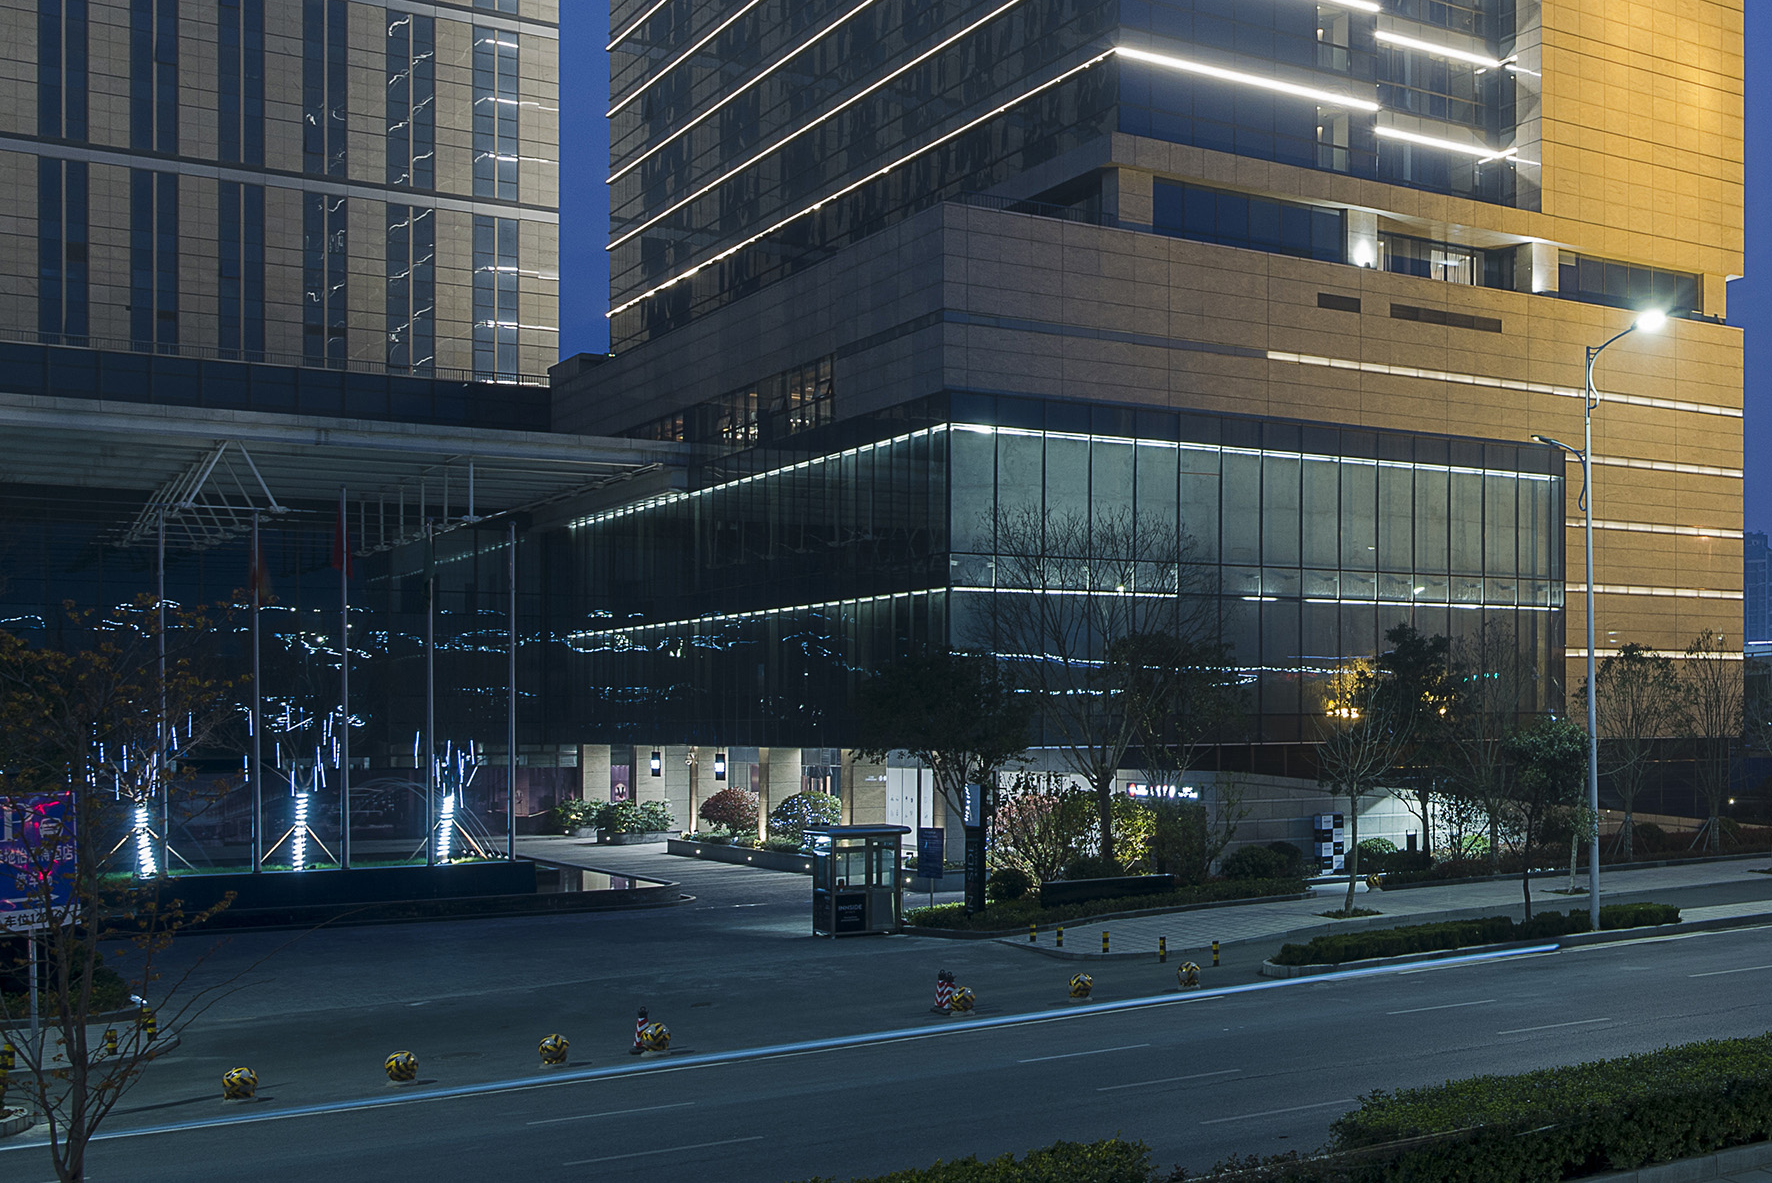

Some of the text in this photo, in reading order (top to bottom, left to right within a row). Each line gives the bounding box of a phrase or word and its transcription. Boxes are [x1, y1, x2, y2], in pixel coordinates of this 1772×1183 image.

[0, 845, 73, 864] 地怡思得酒店
[5, 911, 63, 927] 车位12个
